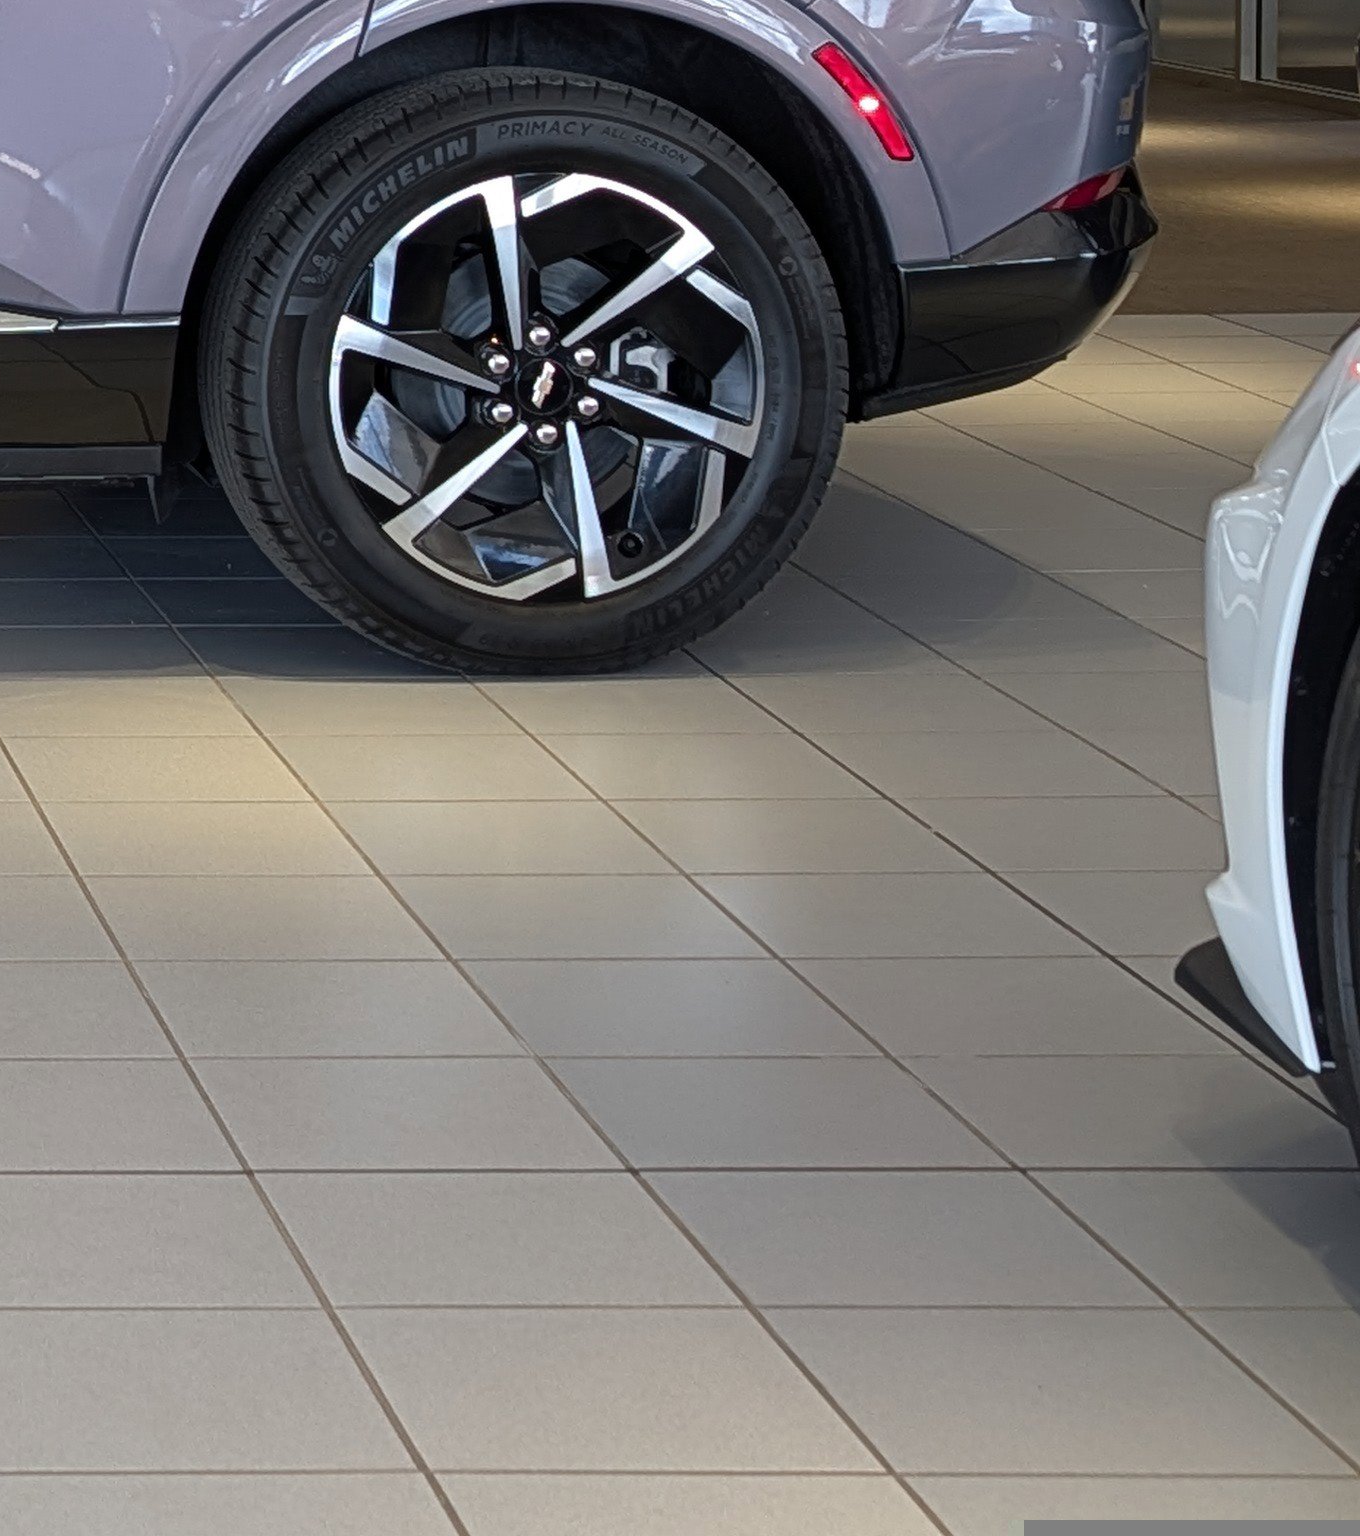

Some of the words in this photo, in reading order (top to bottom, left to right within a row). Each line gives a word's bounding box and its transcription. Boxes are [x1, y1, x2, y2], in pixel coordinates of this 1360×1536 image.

[497, 120, 596, 141] PRIMACY
[600, 126, 627, 139] ALL
[630, 134, 689, 165] SEASON
[328, 135, 470, 251] MICHELIN
